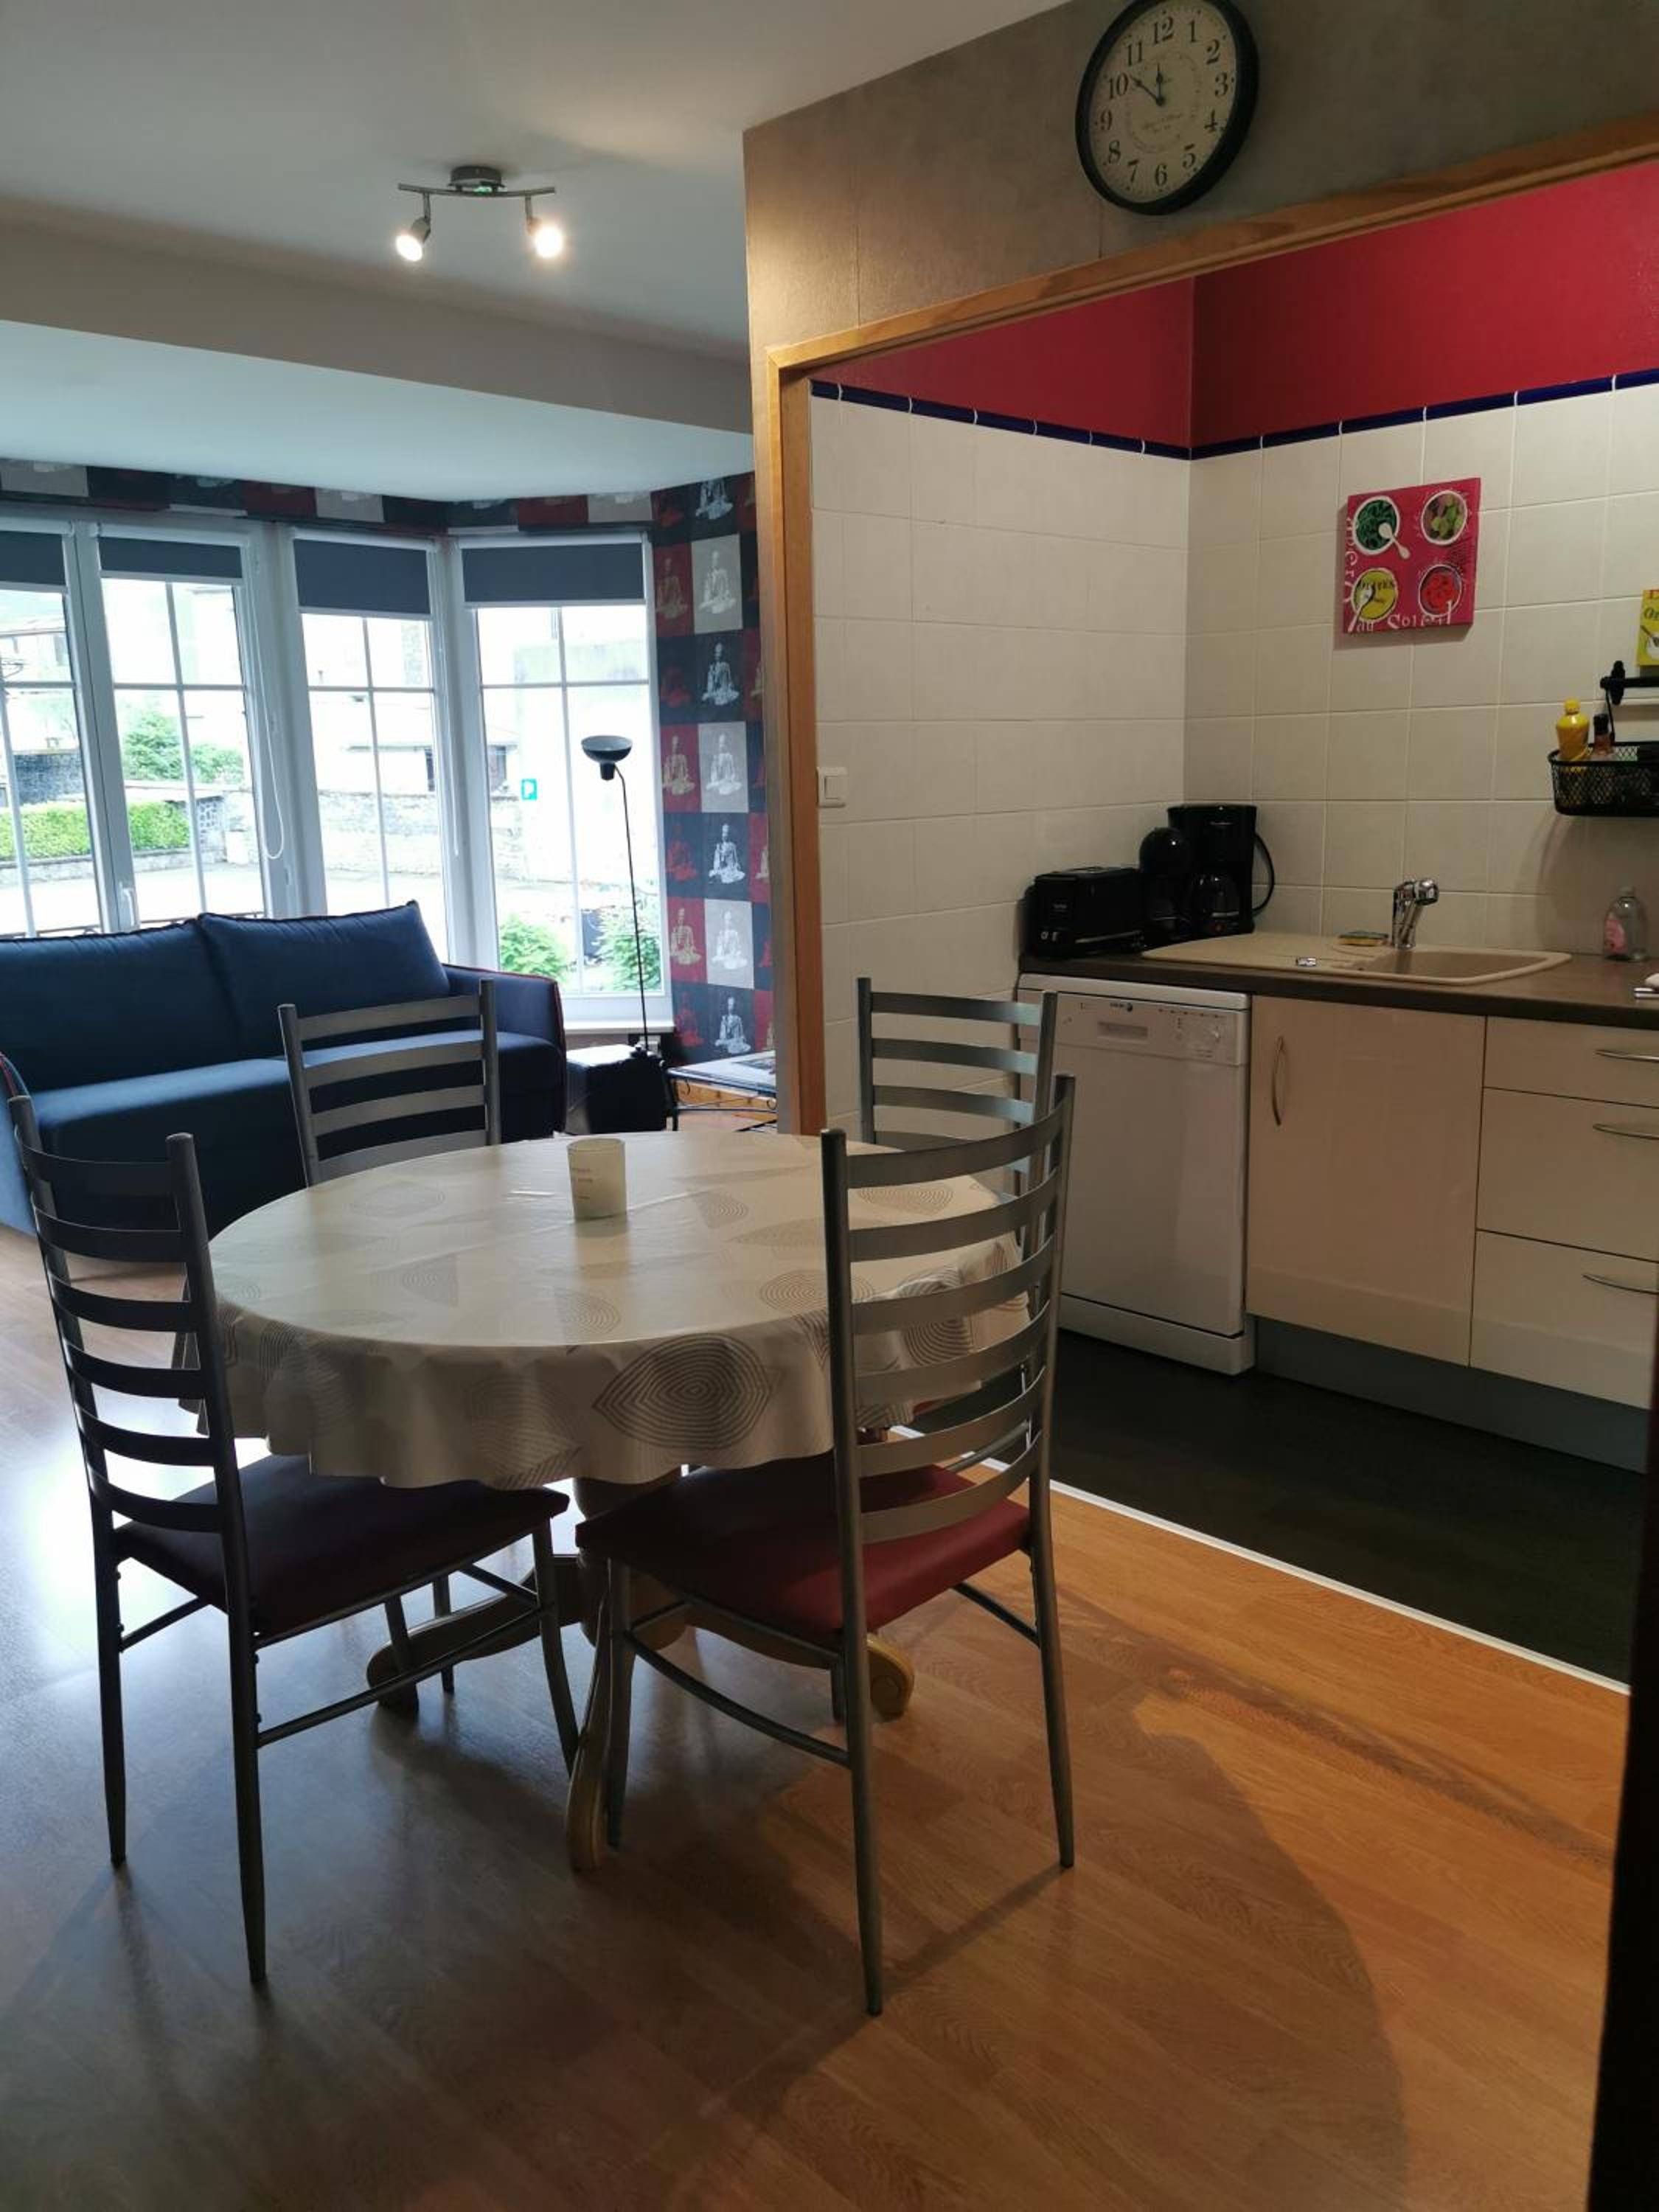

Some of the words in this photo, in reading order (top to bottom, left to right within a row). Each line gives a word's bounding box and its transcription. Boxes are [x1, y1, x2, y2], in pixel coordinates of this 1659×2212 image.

[1152, 16, 1175, 45] 12
[1188, 20, 1197, 43] 1
[1126, 41, 1143, 66] 11
[1206, 39, 1220, 65] 2
[1108, 72, 1129, 100] 10
[1214, 72, 1229, 97] 3
[1100, 110, 1113, 131] 9
[1204, 110, 1218, 133] 4
[1108, 140, 1121, 164] 8
[1182, 143, 1197, 170] 5
[1127, 159, 1139, 183] 7
[1155, 164, 1168, 186] 6
[524, 781, 535, 799] P
